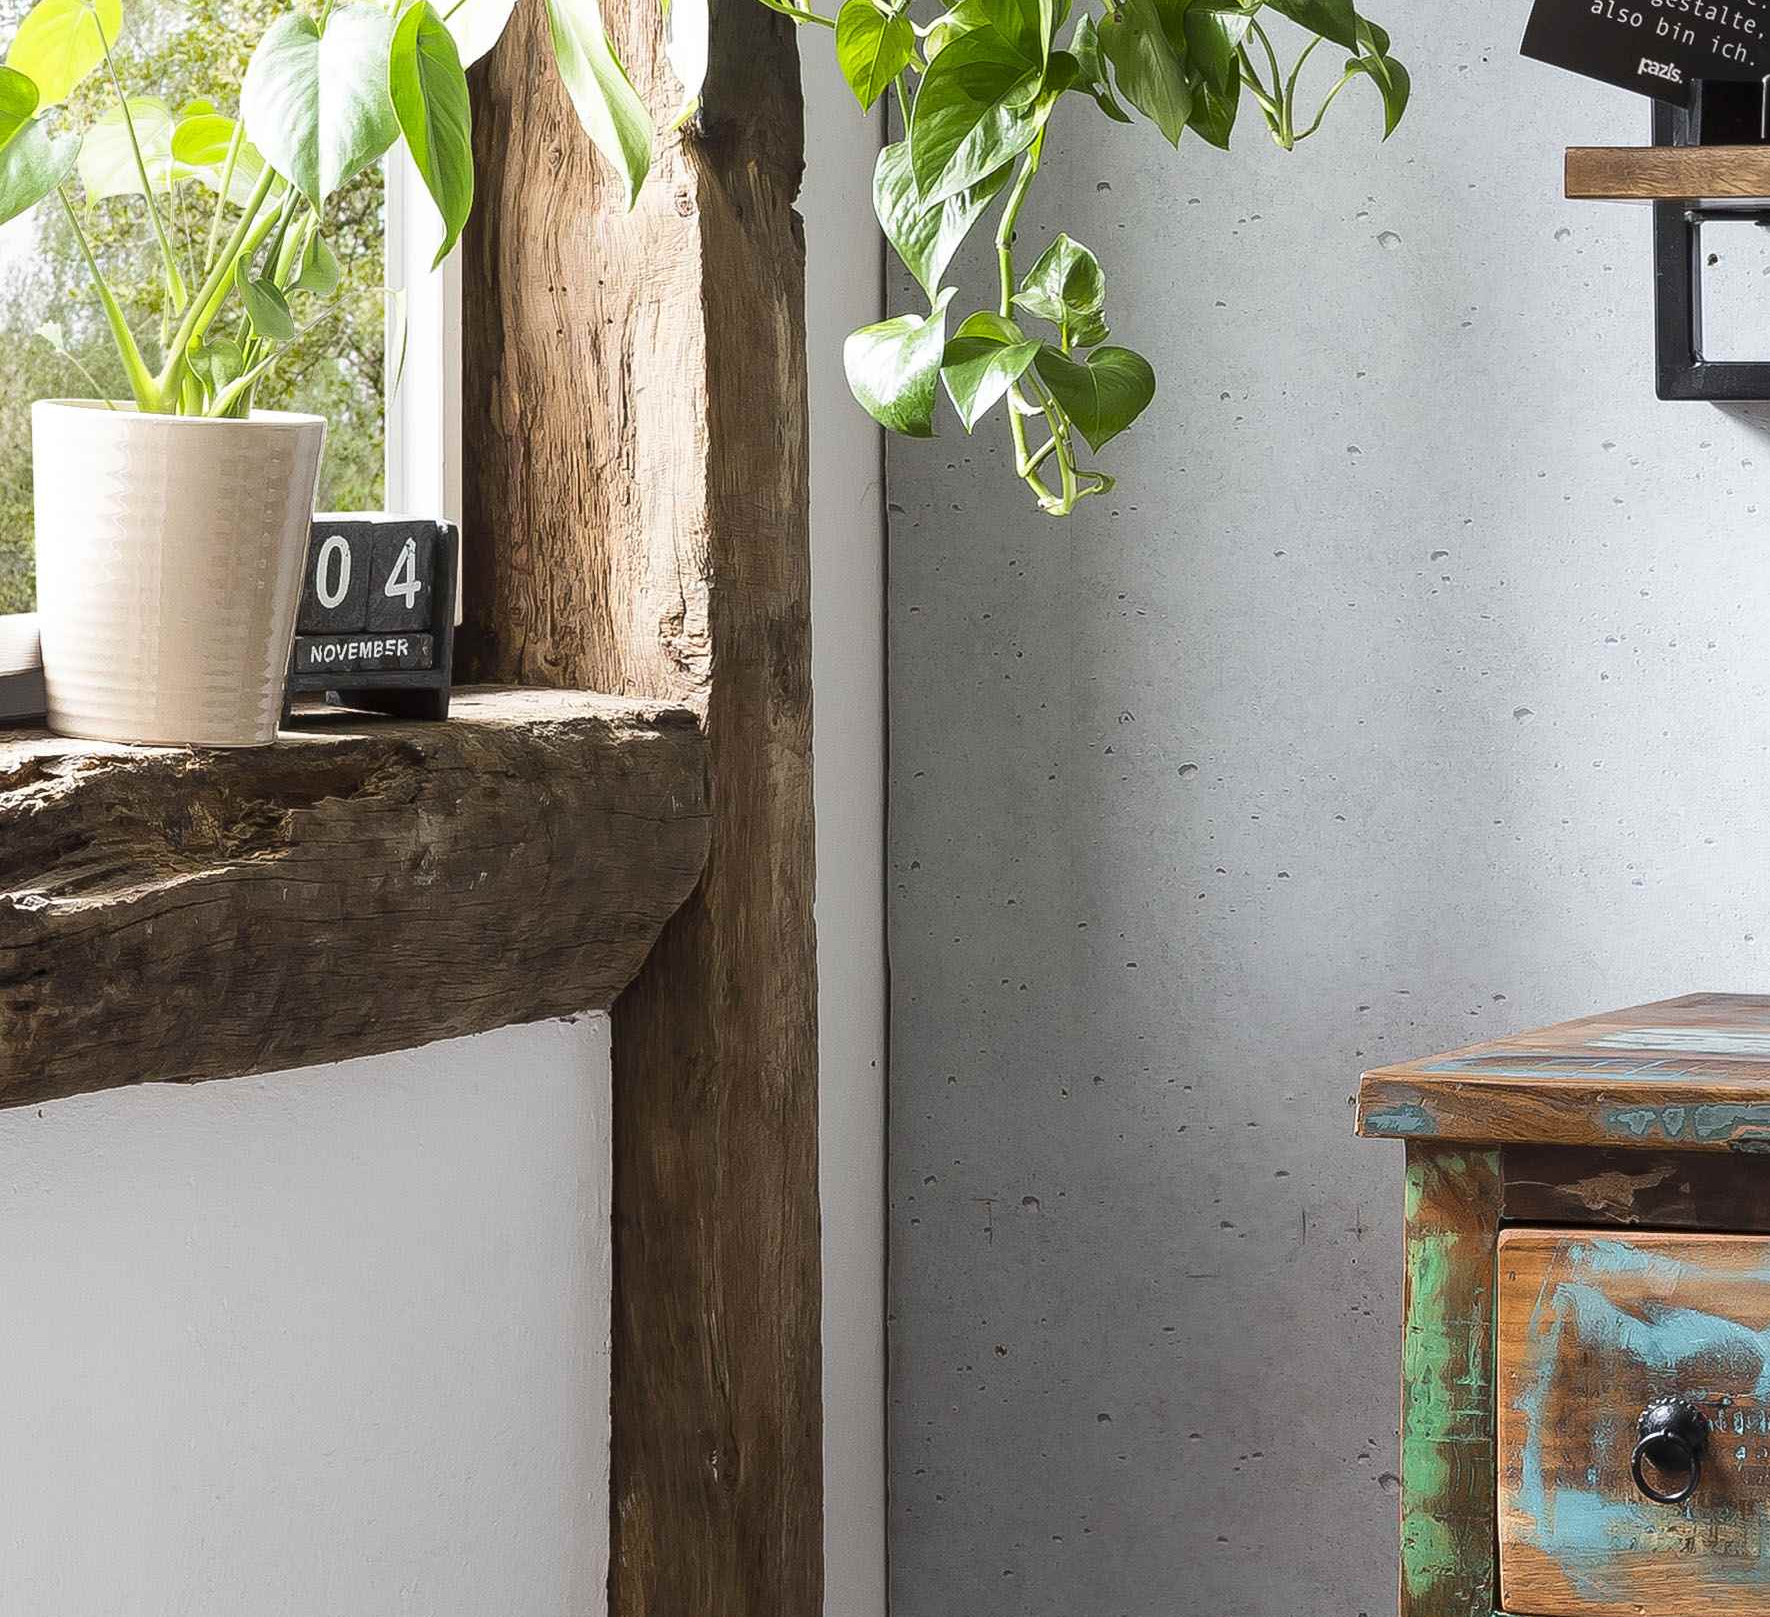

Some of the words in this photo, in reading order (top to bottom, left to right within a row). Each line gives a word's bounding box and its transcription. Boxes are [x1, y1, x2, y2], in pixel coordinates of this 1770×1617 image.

[1590, 0, 1643, 27] also
[1655, 17, 1695, 45] bin
[1711, 35, 1756, 67] ich.
[310, 638, 409, 663] NOVEMBER
